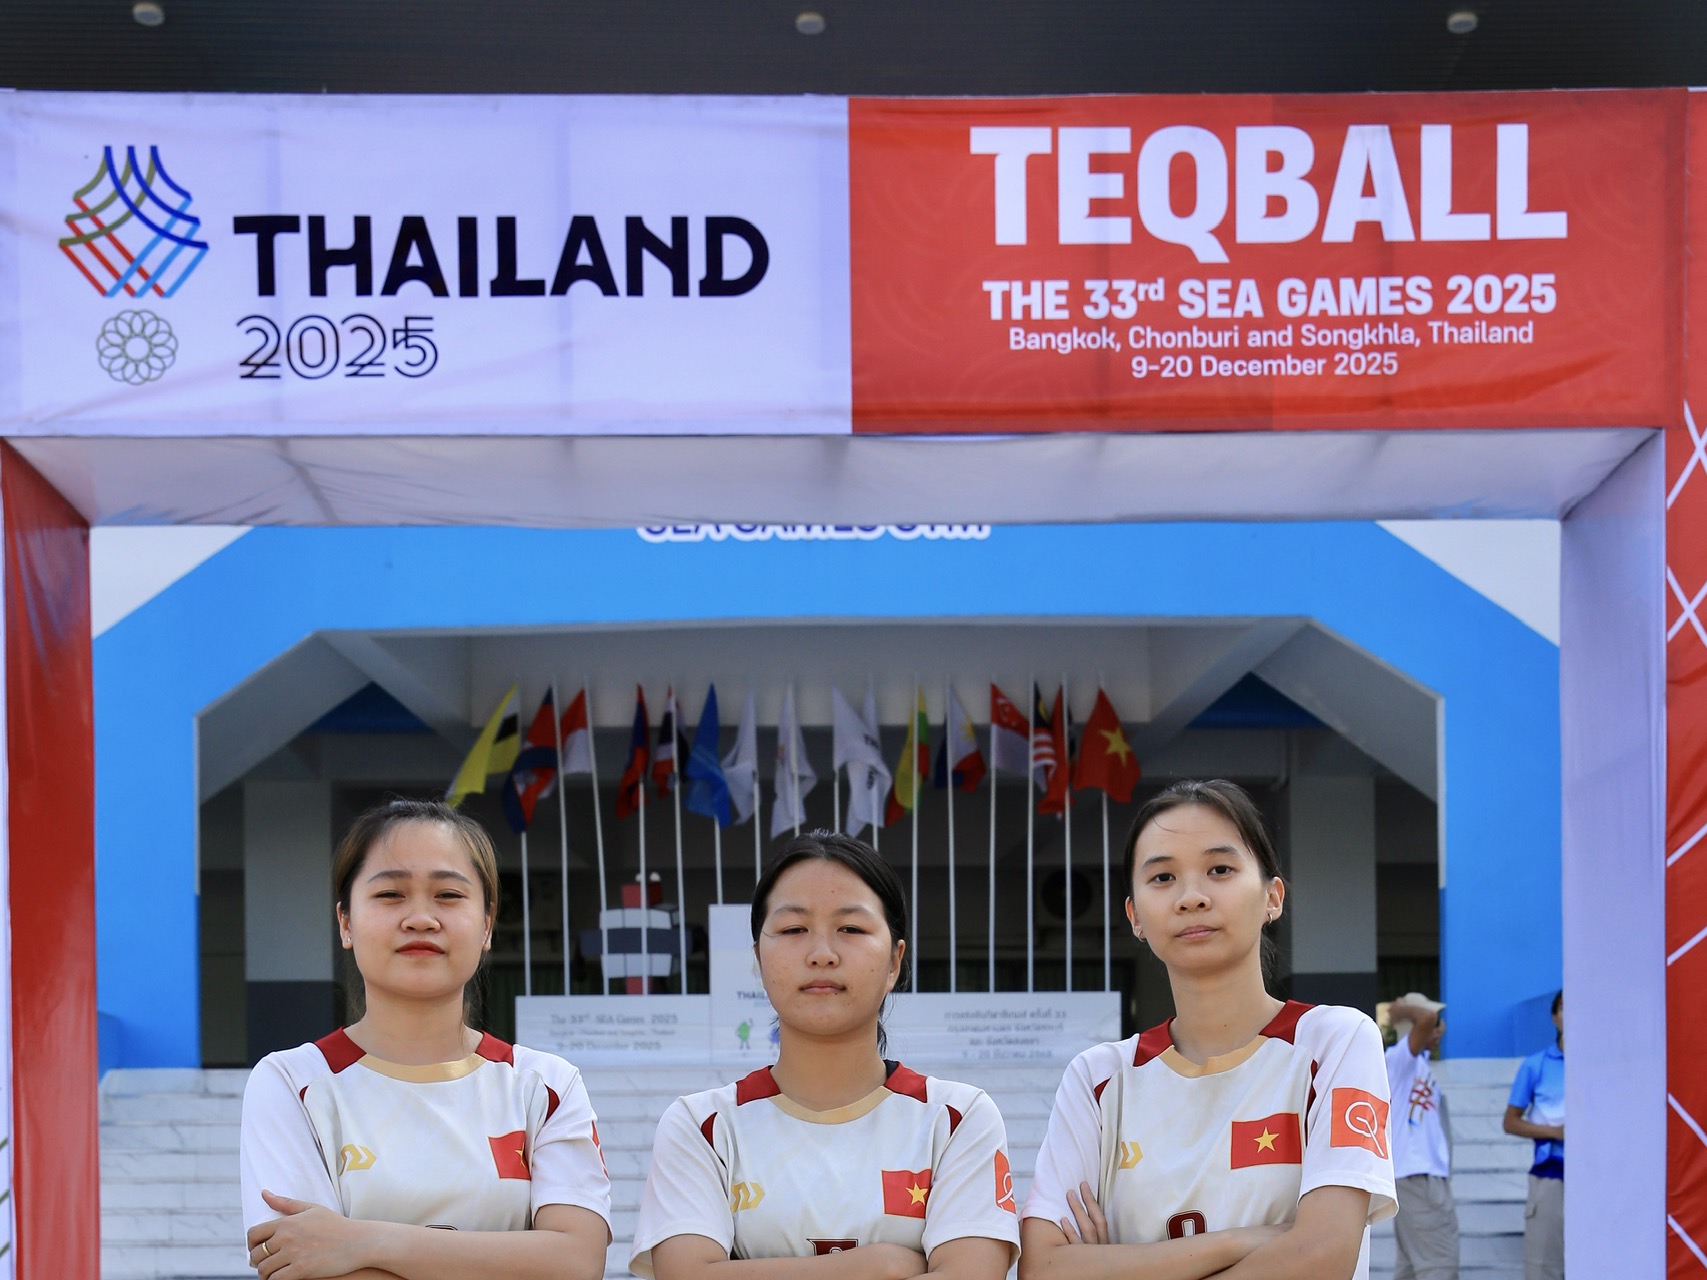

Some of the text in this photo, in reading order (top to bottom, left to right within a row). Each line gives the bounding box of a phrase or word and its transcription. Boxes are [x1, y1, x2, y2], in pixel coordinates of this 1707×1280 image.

[968, 123, 1569, 264] TEQBALL
[233, 215, 770, 297] THAILAND
[982, 273, 1557, 321] THE 33rd SEA GAMES 2025
[238, 313, 440, 380] 2025
[1008, 320, 1535, 354] Bangkok, Chonburi and Songkhla, Thailand
[1131, 352, 1399, 378] 9-20 December 2025
